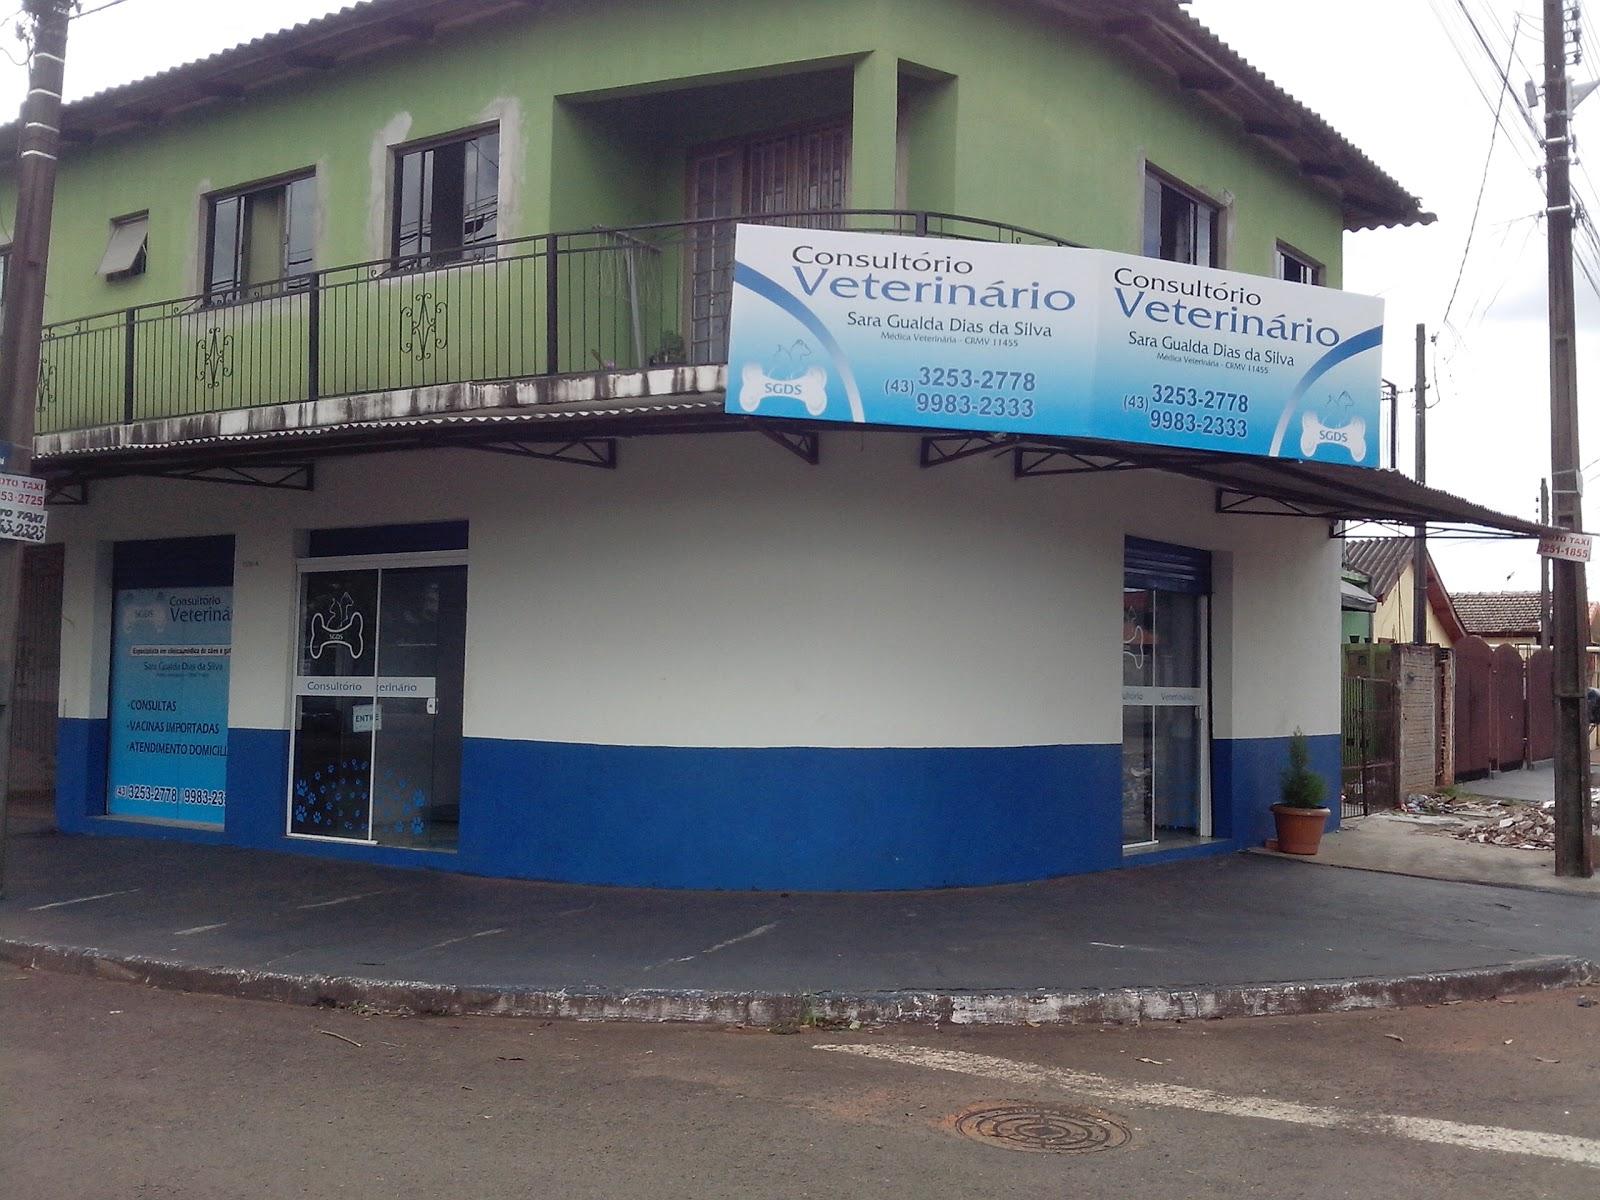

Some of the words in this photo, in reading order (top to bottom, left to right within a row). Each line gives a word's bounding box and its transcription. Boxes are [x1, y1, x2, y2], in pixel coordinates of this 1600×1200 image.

[792, 245, 973, 274] Consultório
[792, 265, 1076, 311] Veterinário
[1114, 267, 1262, 307] Consultório
[847, 311, 881, 328] Sara
[887, 313, 943, 331] Gualda
[950, 317, 984, 334] Dias
[989, 319, 1009, 335] da
[1014, 321, 1052, 337] Silva
[1114, 287, 1340, 347] Veterinário
[881, 331, 911, 341] Médica
[913, 333, 957, 344] Veterinária
[964, 337, 990, 346] CRMV
[993, 338, 1019, 347] 11455
[1128, 330, 1158, 348] Sara
[1162, 335, 1209, 355] Gualda
[1213, 342, 1241, 359] Dias
[1244, 347, 1261, 362] da
[1264, 349, 1295, 367] Silva
[1156, 352, 1182, 362] Médica
[1184, 356, 1219, 368] Veterinária
[1225, 361, 1246, 371] CRMV
[1247, 363, 1269, 375] 11455
[764, 381, 802, 396] SGDS
[885, 378, 915, 396] (43)
[919, 366, 1036, 392] 3253-2778
[916, 392, 1035, 418] 9983-2333
[1123, 395, 1149, 413] (43)
[1152, 384, 1249, 413] 3253-2778
[1150, 409, 1248, 438] 9983-2333
[1319, 428, 1348, 443] SGDS
[21, 480, 44, 491] TAXI
[1569, 536, 1590, 546] TAXI
[169, 595, 221, 607] Consultório
[170, 606, 233, 622] Veteriná
[307, 681, 362, 691] Consultório
[376, 682, 417, 692] erinário
[166, 722, 220, 735] IMPORTADAS
[128, 785, 177, 802] 3253-2778
[184, 789, 225, 805] 9983-23
